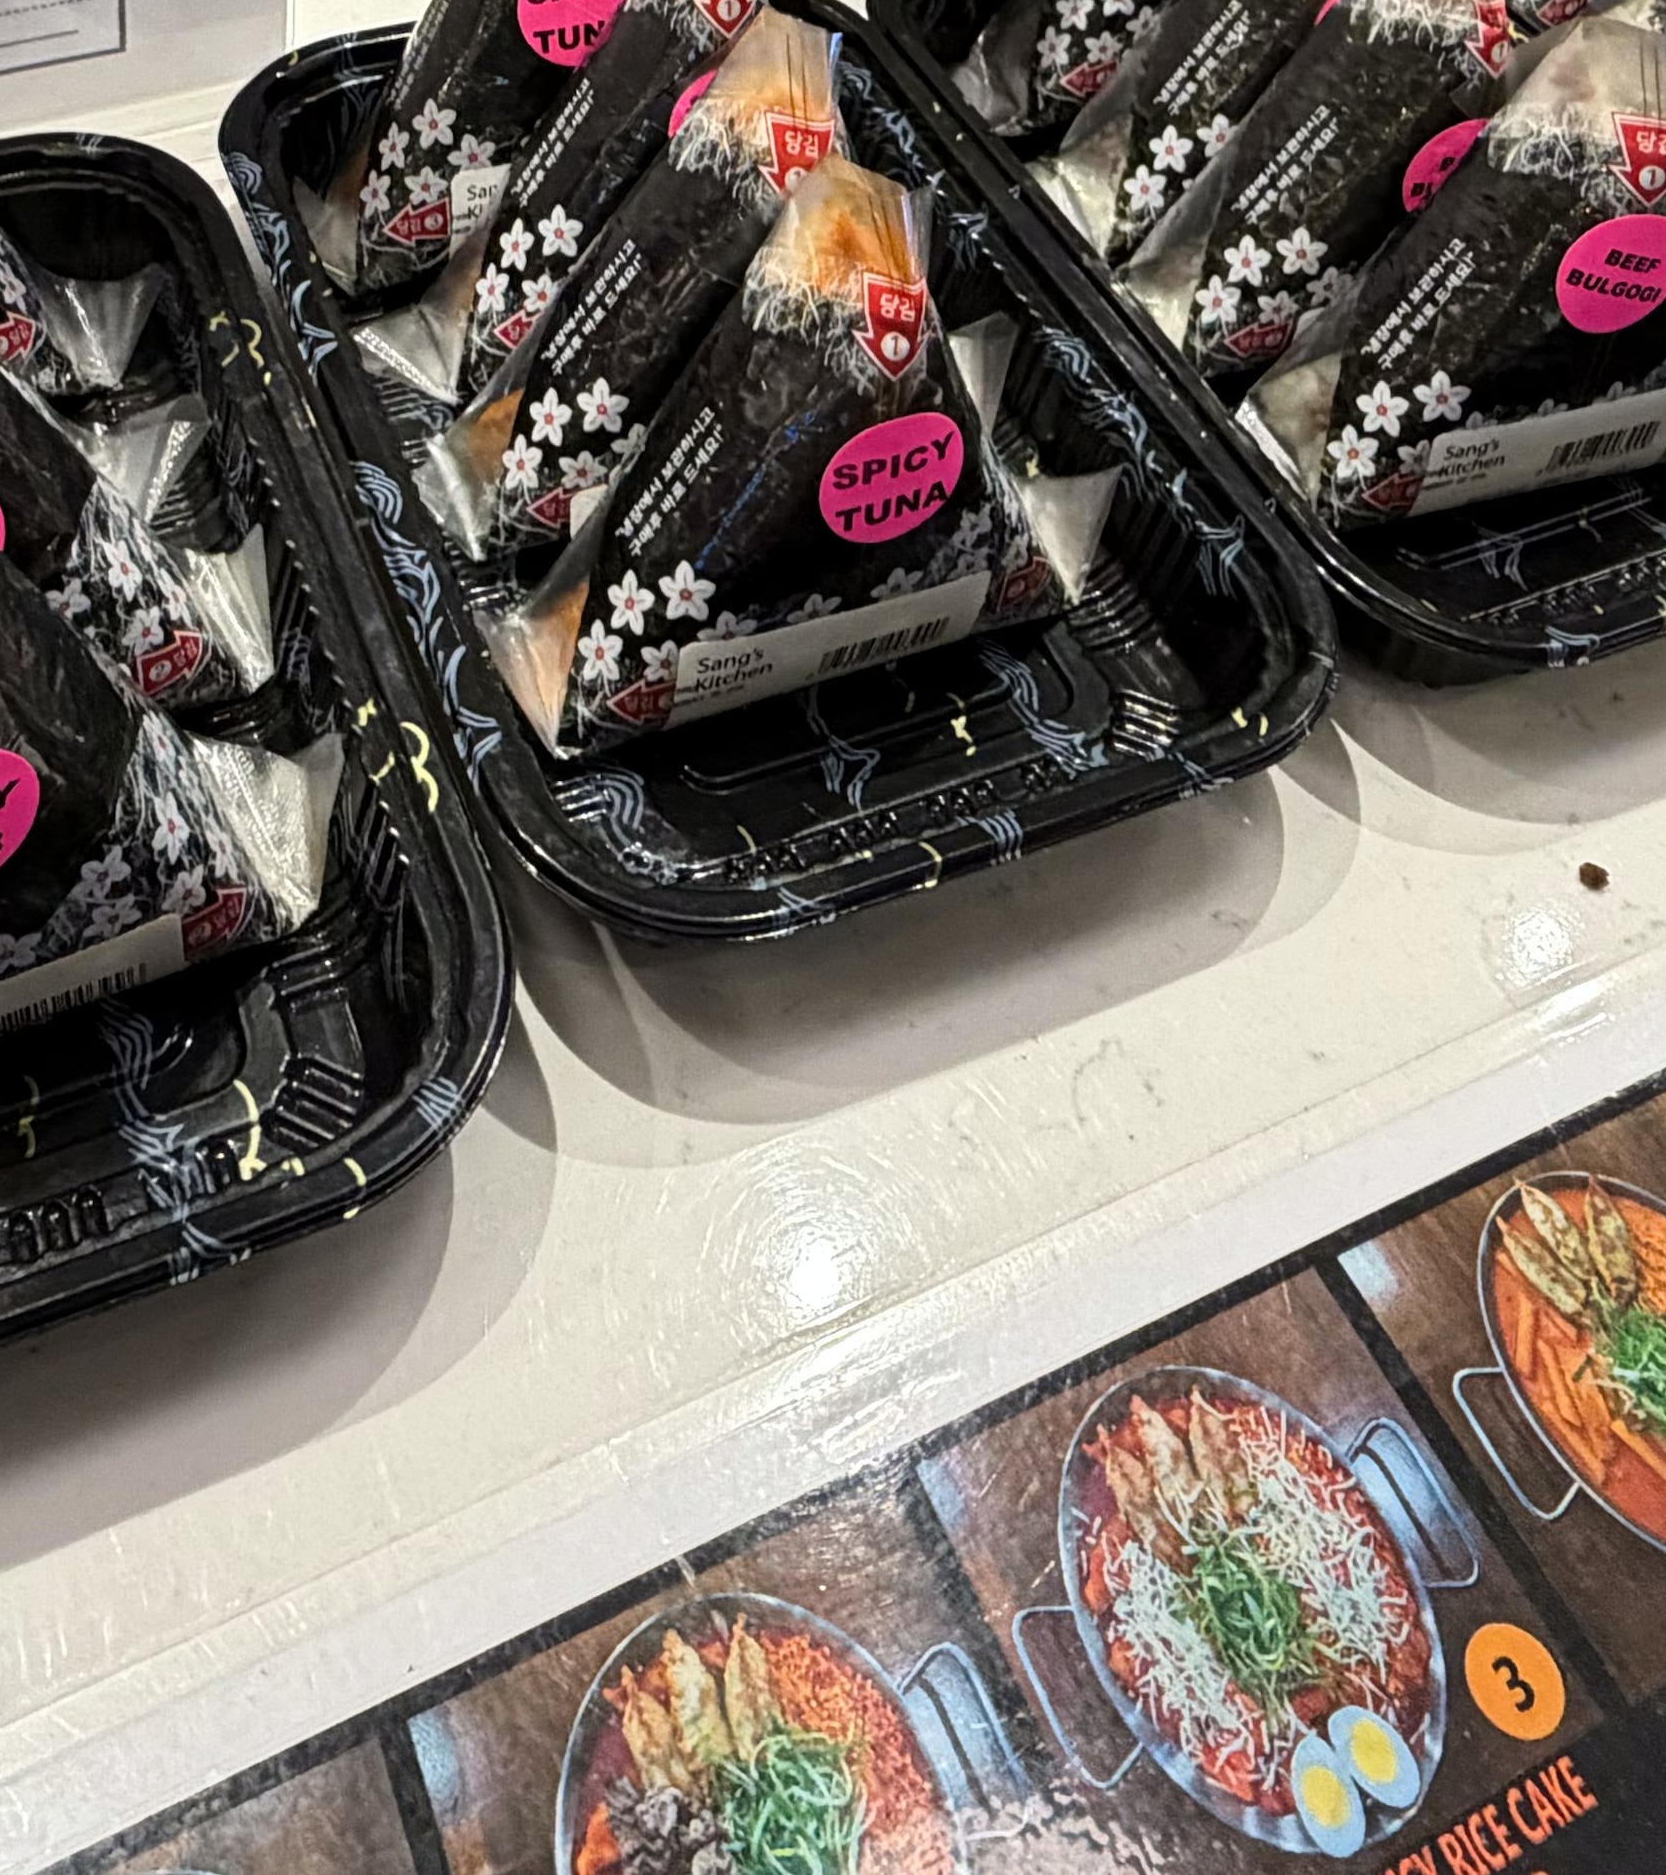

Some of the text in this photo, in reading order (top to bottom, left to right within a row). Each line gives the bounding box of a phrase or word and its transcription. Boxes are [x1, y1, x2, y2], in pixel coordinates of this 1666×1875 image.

[1604, 248, 1661, 274] BEEF
[1564, 268, 1662, 306] BULGOGI
[832, 432, 955, 491] SPICY
[1438, 454, 1506, 478] Kitchen
[1443, 437, 1501, 461] Sang's
[833, 483, 950, 533] TUNA
[693, 662, 774, 692] Kitchen
[696, 647, 765, 675] Sang's
[1493, 1654, 1536, 1713] 3
[1437, 1755, 1599, 1875] RICE CAKE
